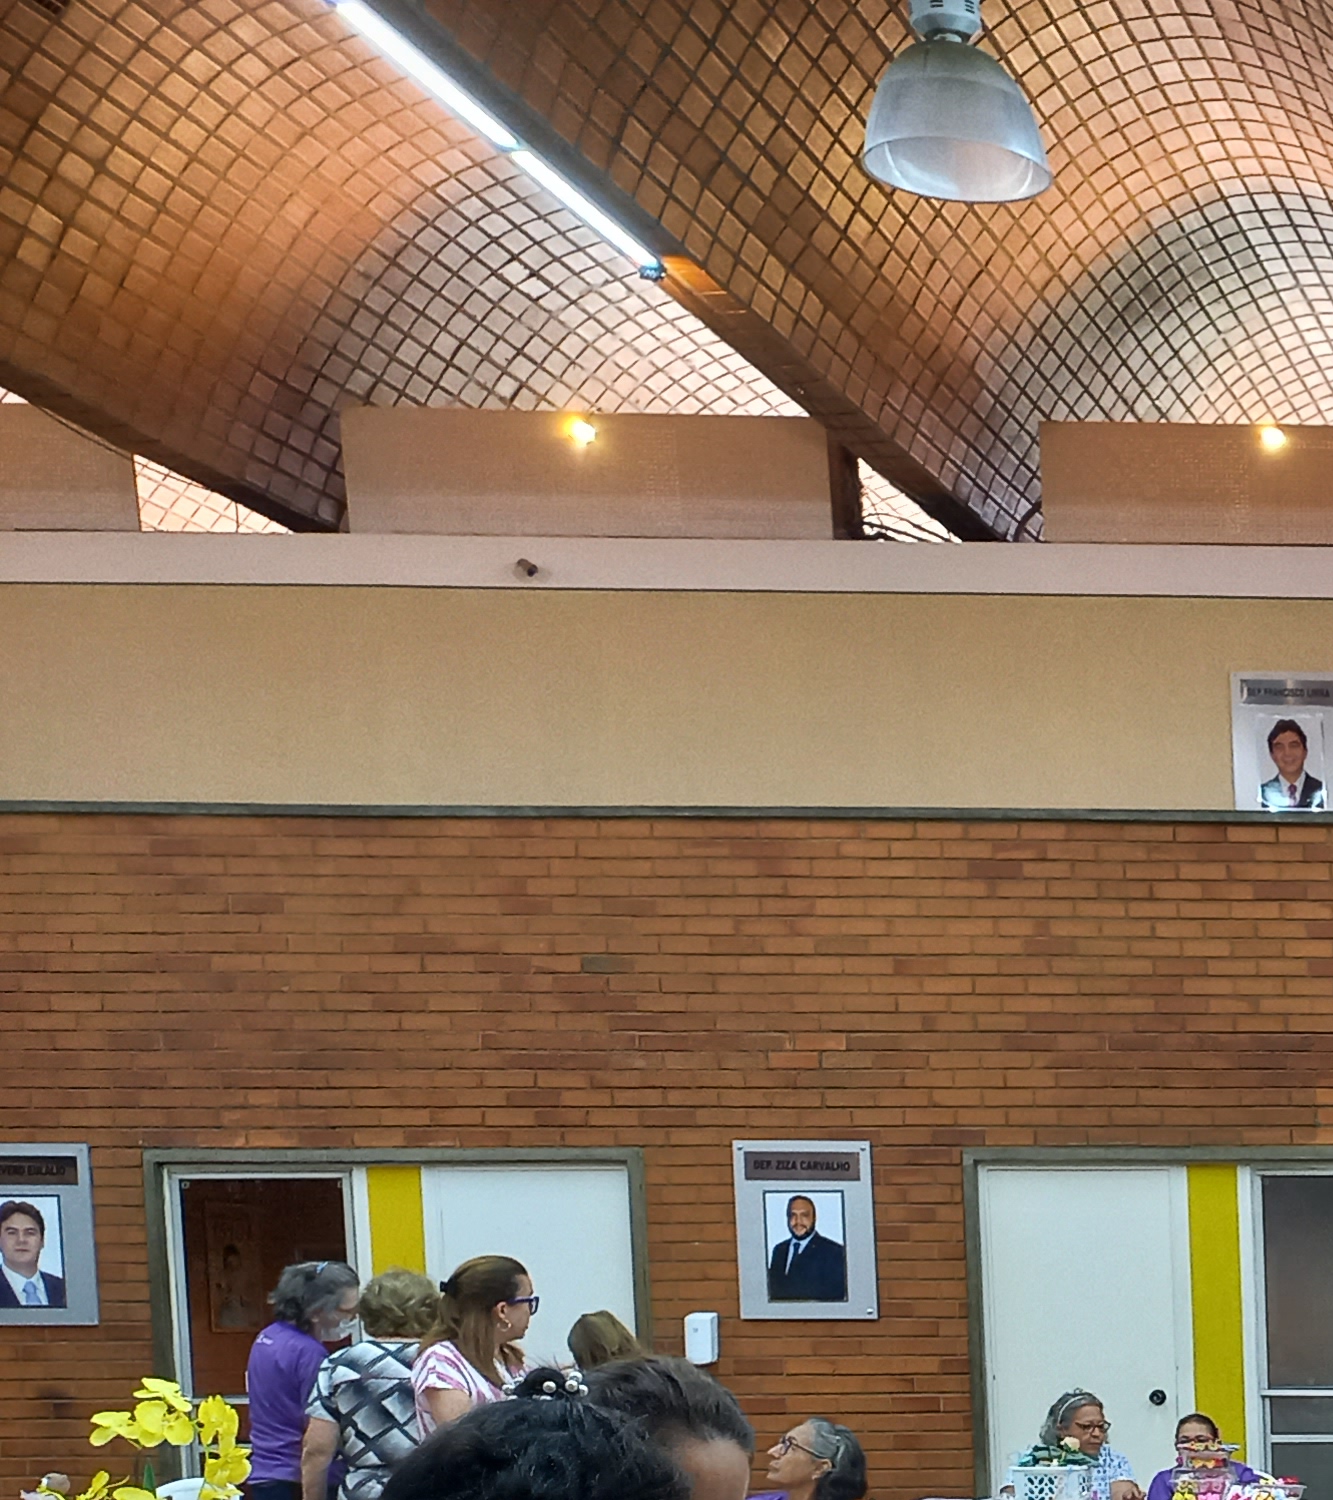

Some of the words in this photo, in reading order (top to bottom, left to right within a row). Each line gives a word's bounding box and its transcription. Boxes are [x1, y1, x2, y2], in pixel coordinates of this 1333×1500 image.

[753, 1159, 773, 1171] DEP.
[775, 1160, 798, 1172] ZIZA
[799, 1160, 851, 1173] CARVALHO
